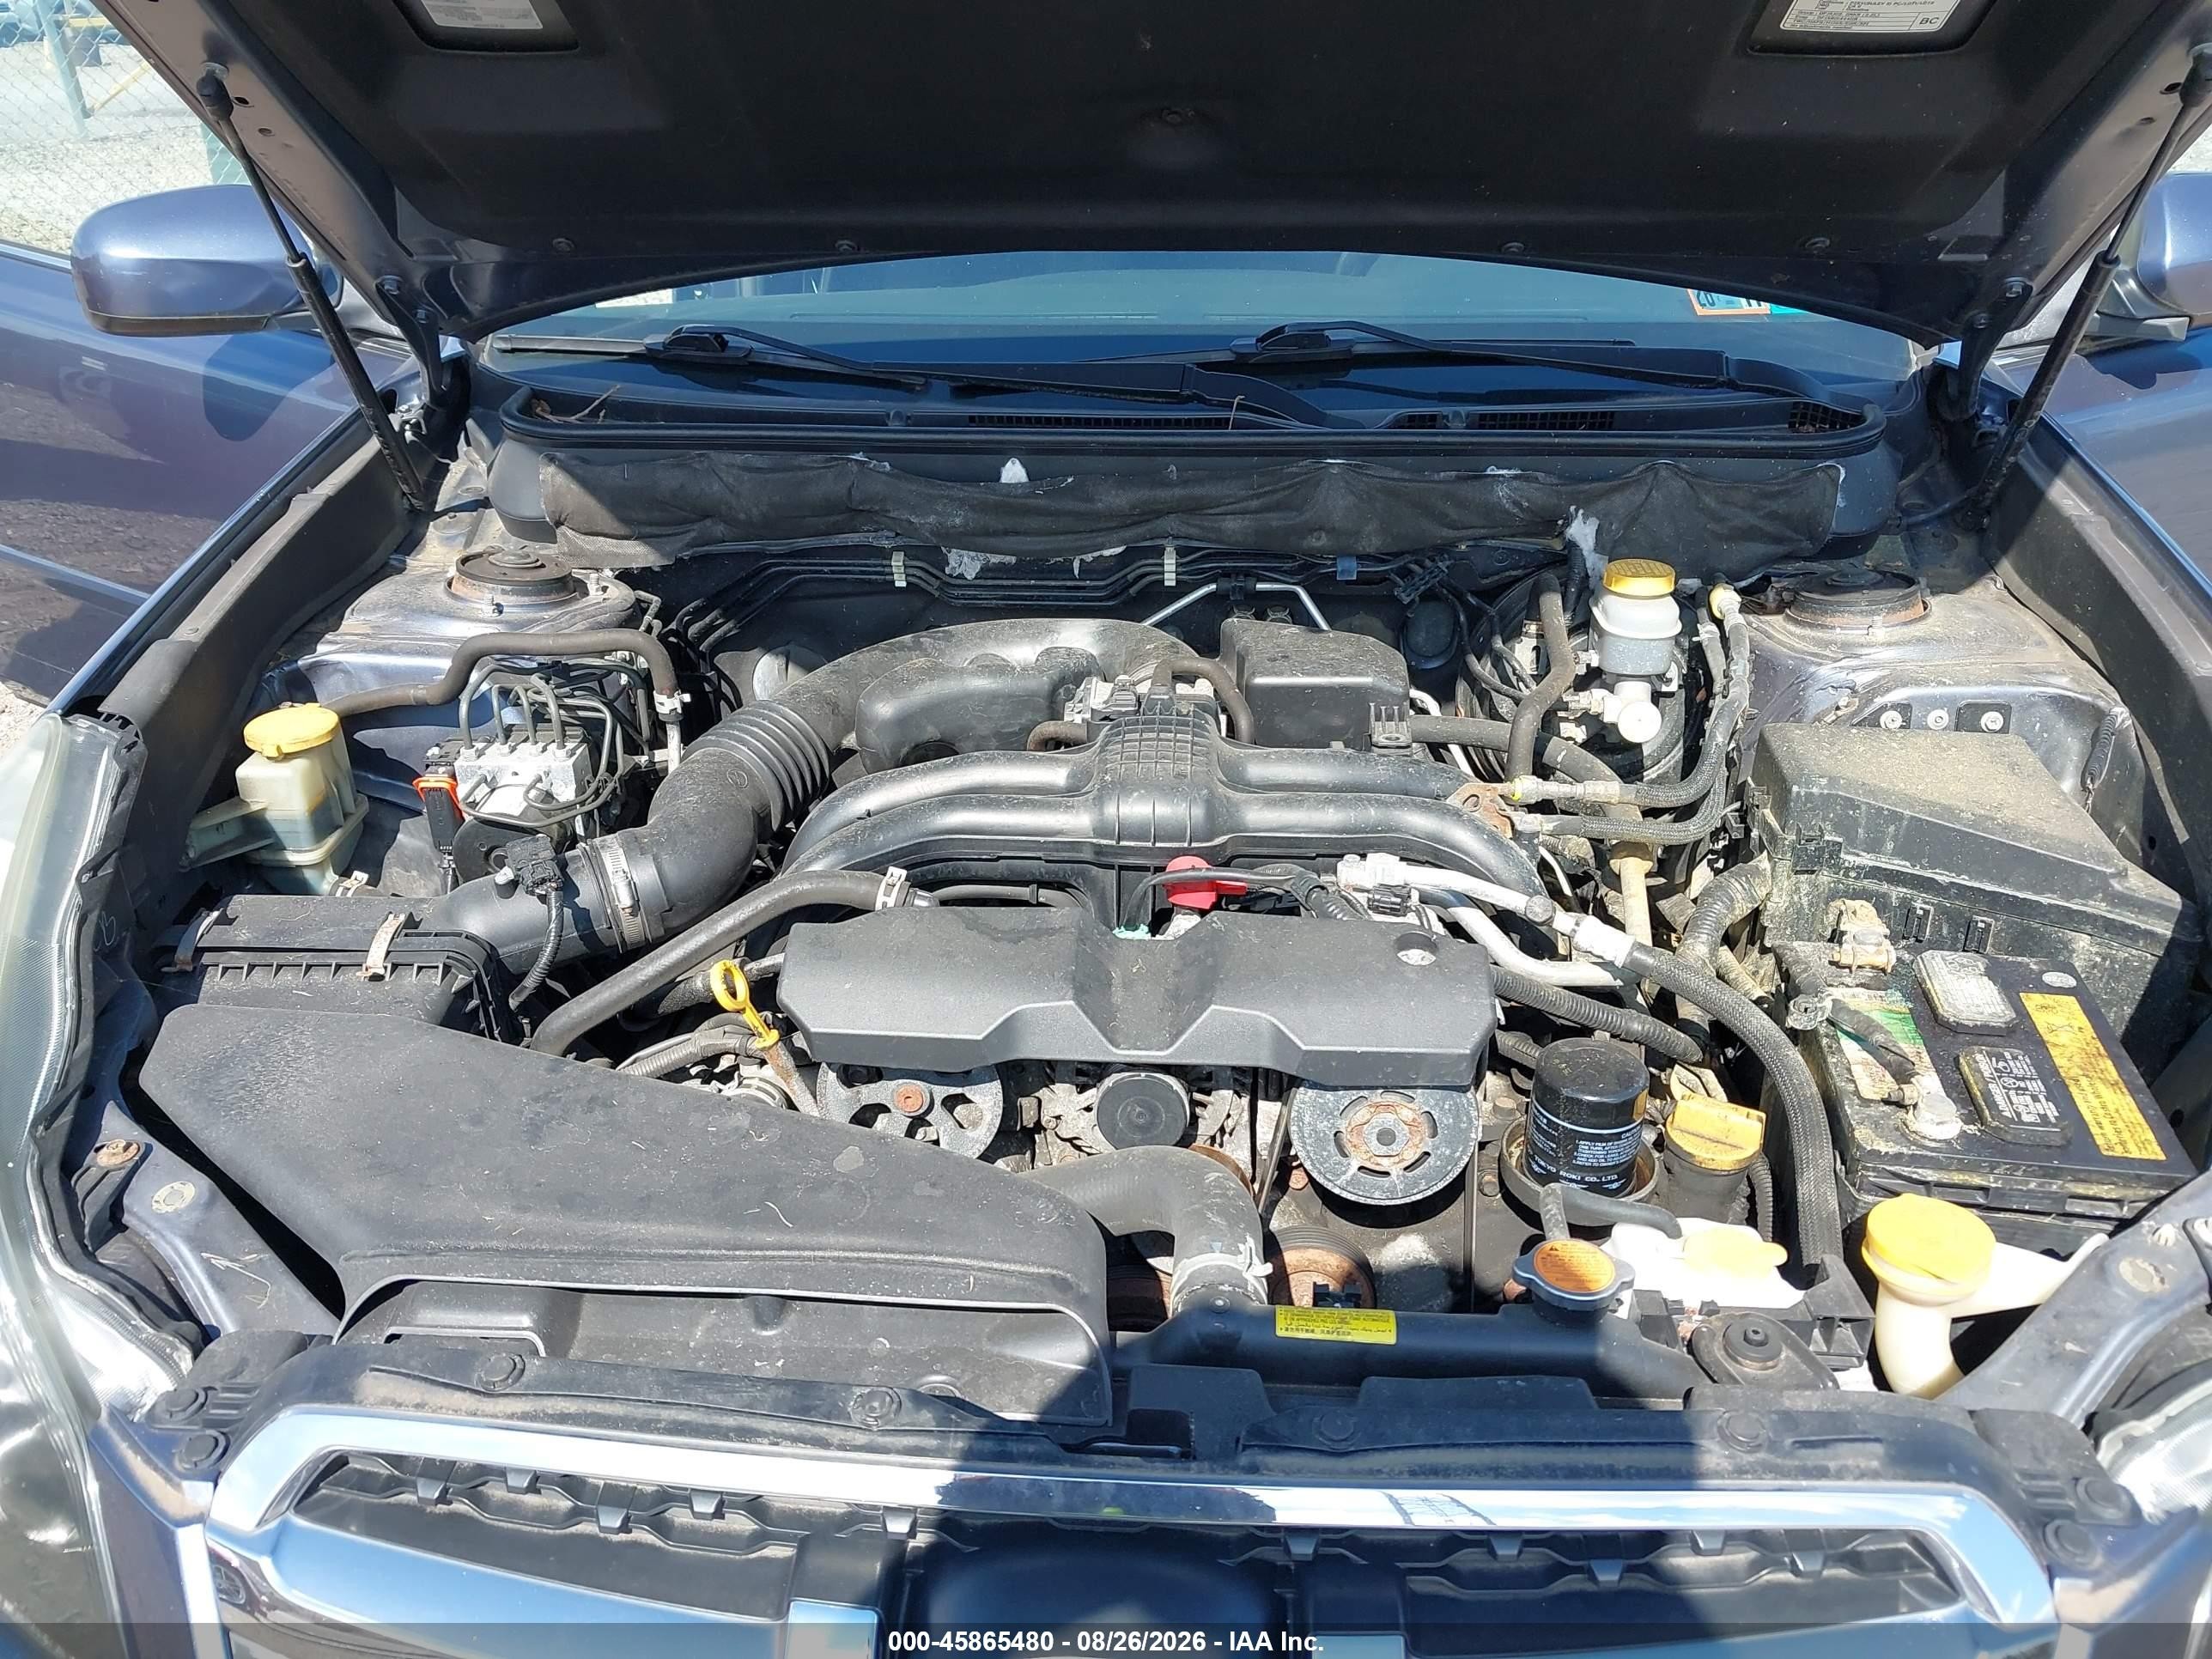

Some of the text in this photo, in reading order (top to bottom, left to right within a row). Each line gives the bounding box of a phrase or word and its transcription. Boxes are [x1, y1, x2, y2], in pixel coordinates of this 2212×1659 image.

[1918, 16, 1941, 25] BC
[1988, 1083, 2011, 1114] DANGER
[1534, 1154, 1557, 1173] TOKYO
[1559, 1170, 1581, 1181] ROKI
